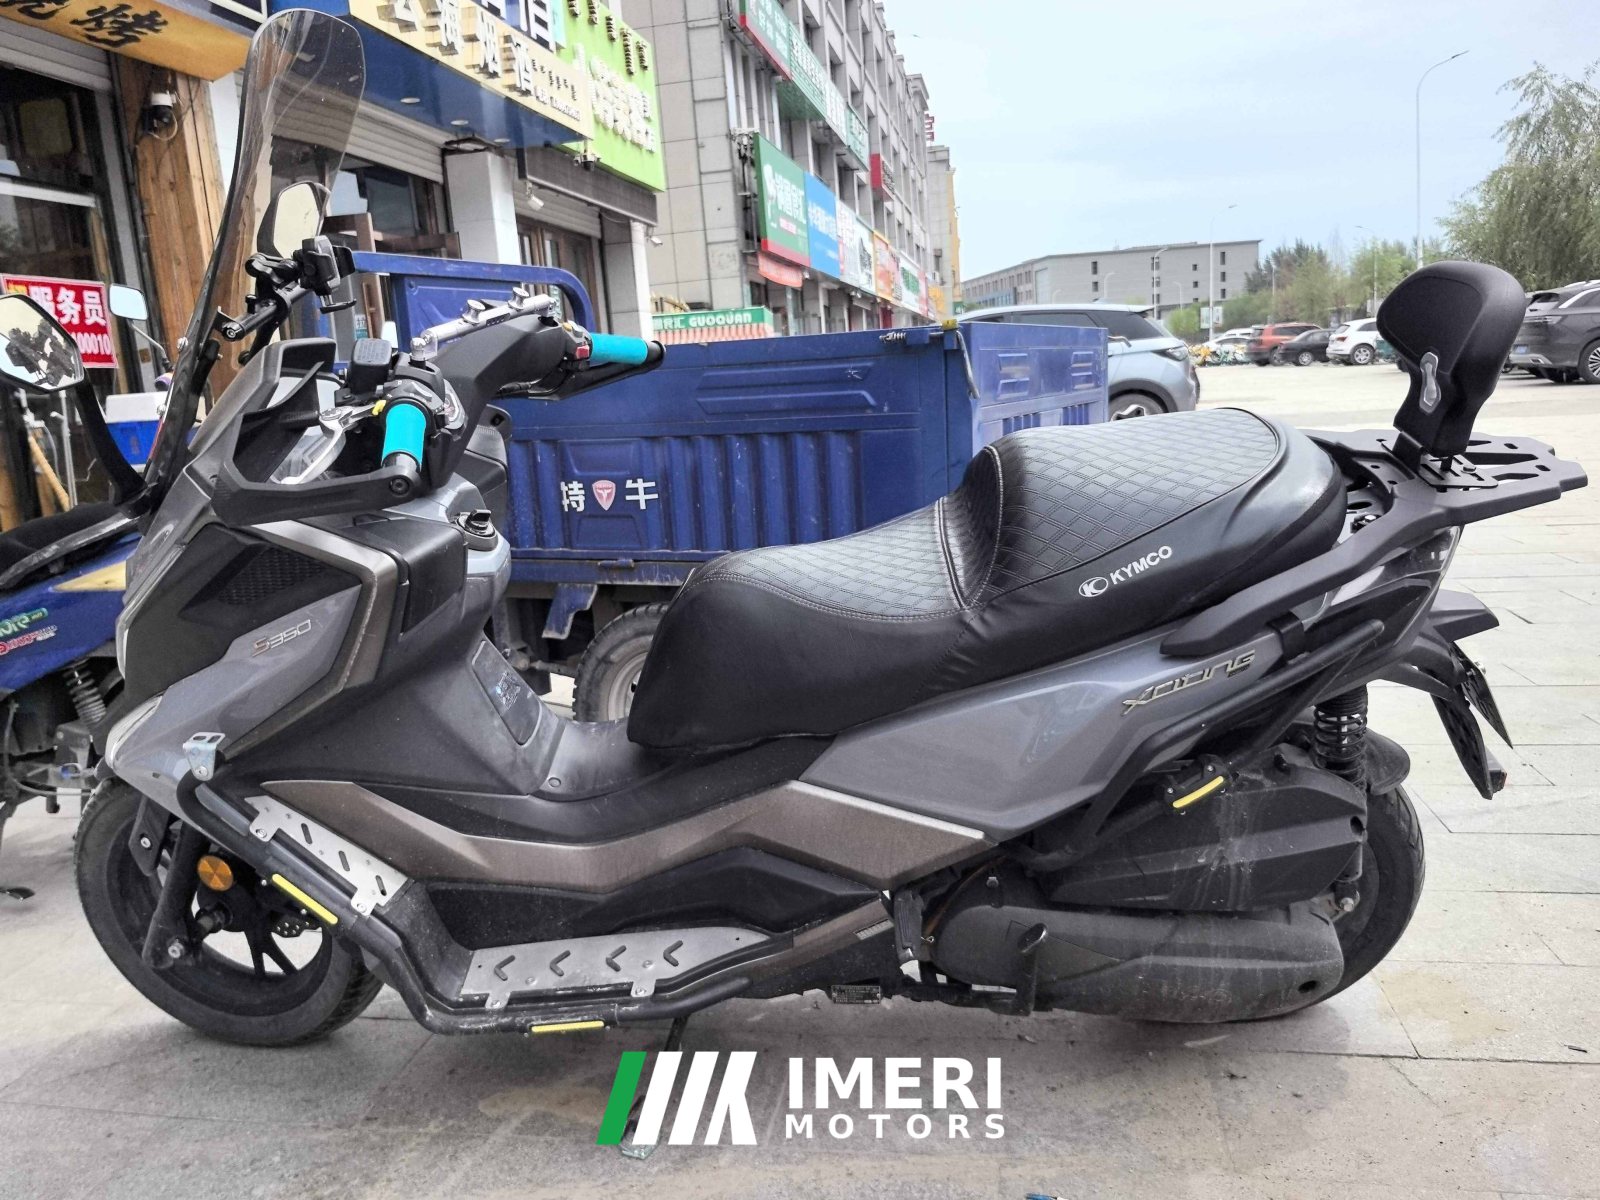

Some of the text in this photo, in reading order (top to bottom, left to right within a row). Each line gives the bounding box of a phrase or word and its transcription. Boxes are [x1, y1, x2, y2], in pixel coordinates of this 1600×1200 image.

[70, 332, 112, 355] 00010
[560, 478, 659, 512] 特 牛
[1109, 545, 1173, 585] KYMCO
[252, 619, 312, 658] S350
